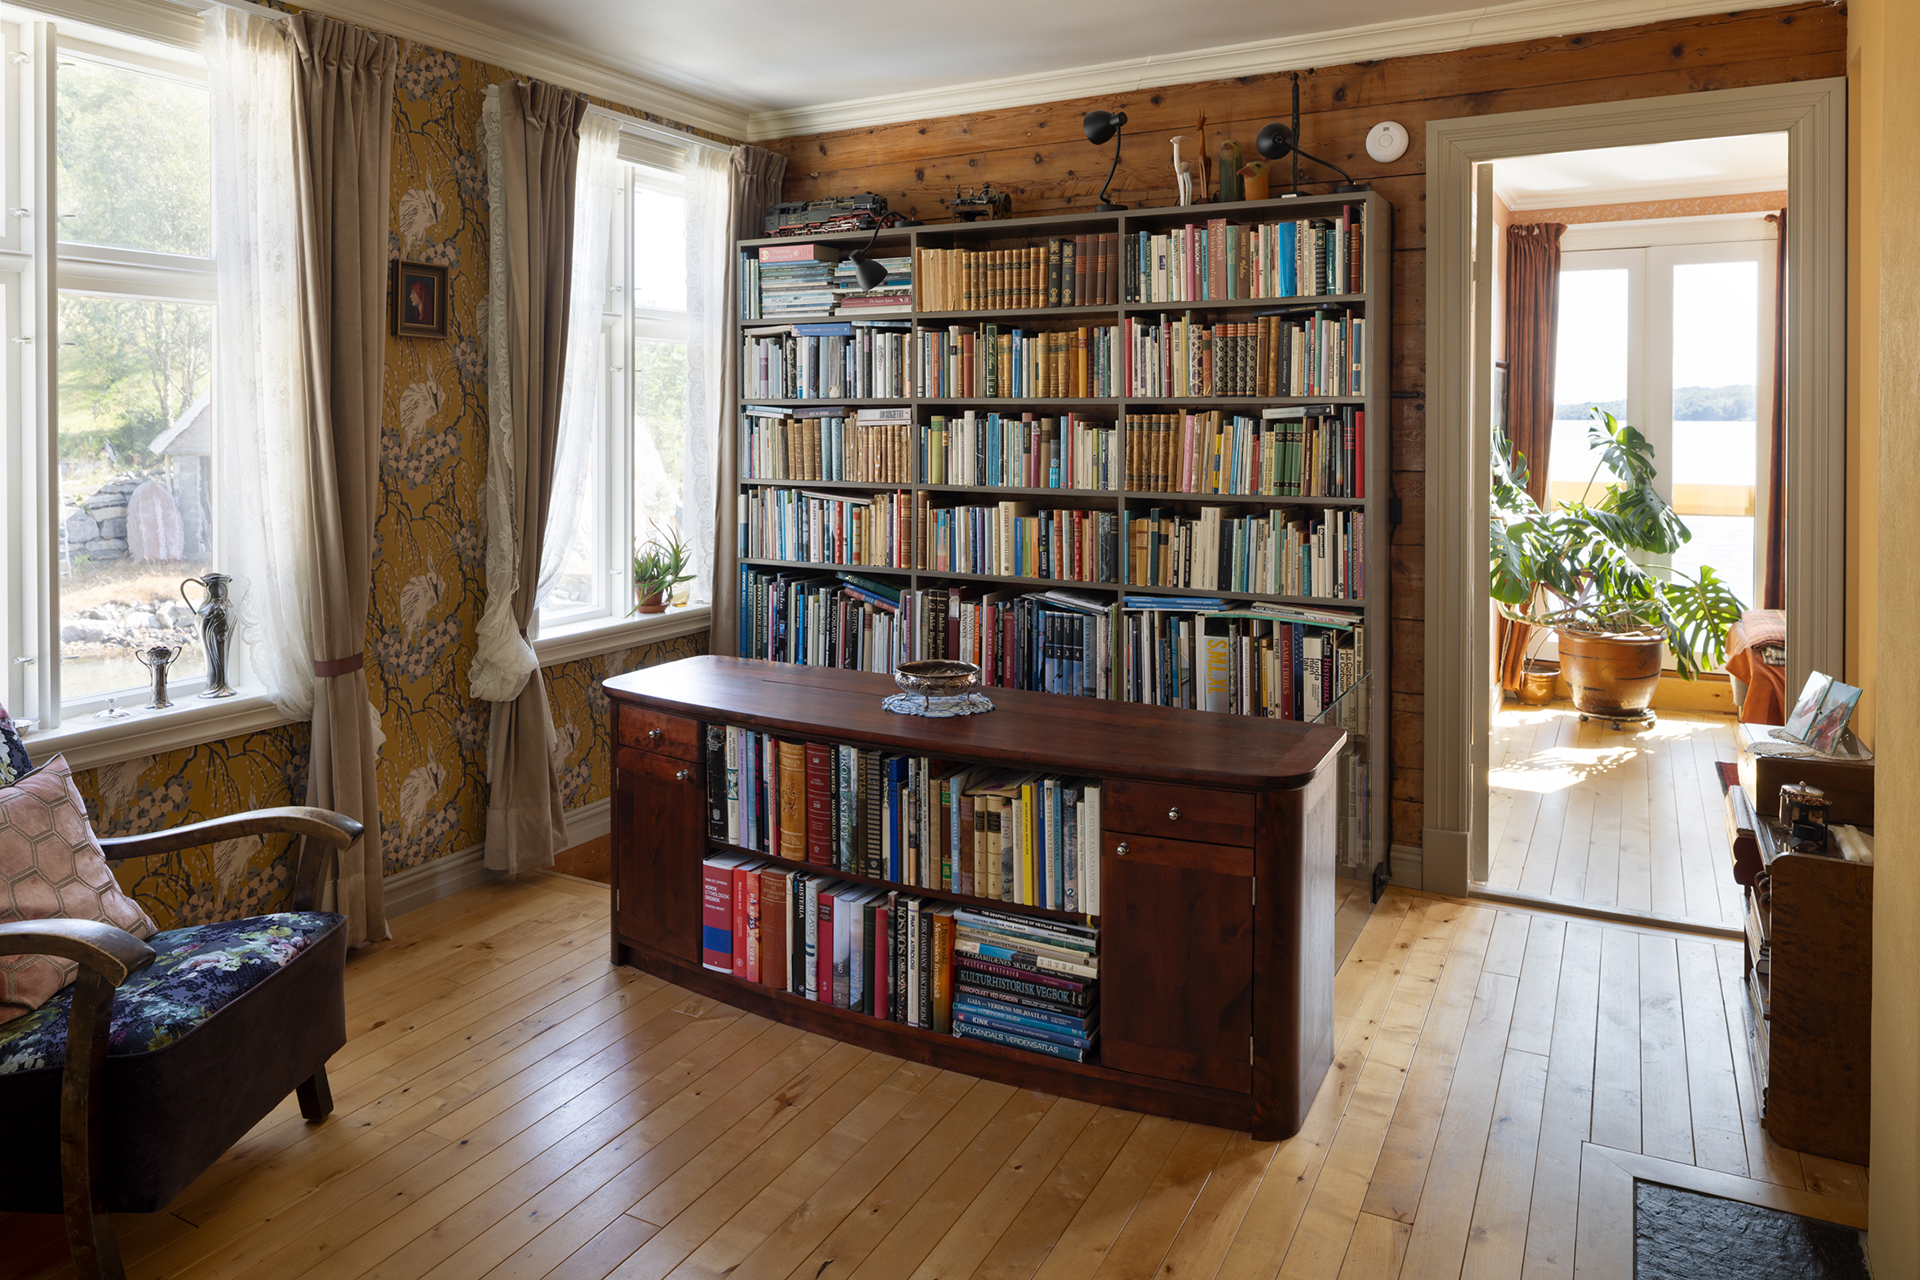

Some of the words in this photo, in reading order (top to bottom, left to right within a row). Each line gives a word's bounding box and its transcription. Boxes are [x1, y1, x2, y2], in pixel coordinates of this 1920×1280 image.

[1344, 427, 1354, 450] FILM
[1066, 808, 1074, 822] Alle
[1047, 830, 1053, 841] OG
[1066, 825, 1074, 846] tiders
[1066, 849, 1074, 880] sangbok
[750, 893, 758, 904] PÅ
[1066, 888, 1074, 897] 2
[990, 911, 1006, 920] GRAPHIC
[1007, 914, 1029, 924] LANGUAGE
[1035, 920, 1053, 930] NEVILLE
[1053, 924, 1067, 933] BRODY
[750, 931, 755, 941] OG
[897, 906, 906, 954] KOSMOS
[988, 938, 1017, 949] ARCHITEKTURA
[1017, 945, 1035, 953] POLSKA
[989, 965, 1019, 977] MYSTERIER
[1012, 961, 1038, 973] SKYGGE
[960, 970, 1035, 994] KULTURHISTORISK
[1036, 985, 1069, 1002] VEGBOK
[921, 997, 927, 1005] OG
[967, 997, 981, 1006] GAIA
[987, 1001, 1012, 1012] VERDENS
[999, 993, 1018, 1003] FJORDEN
[972, 1016, 989, 1026] KINK
[960, 1024, 1003, 1041] GYLDENDALS
[1005, 1033, 1059, 1053] VERDENSATLAS
